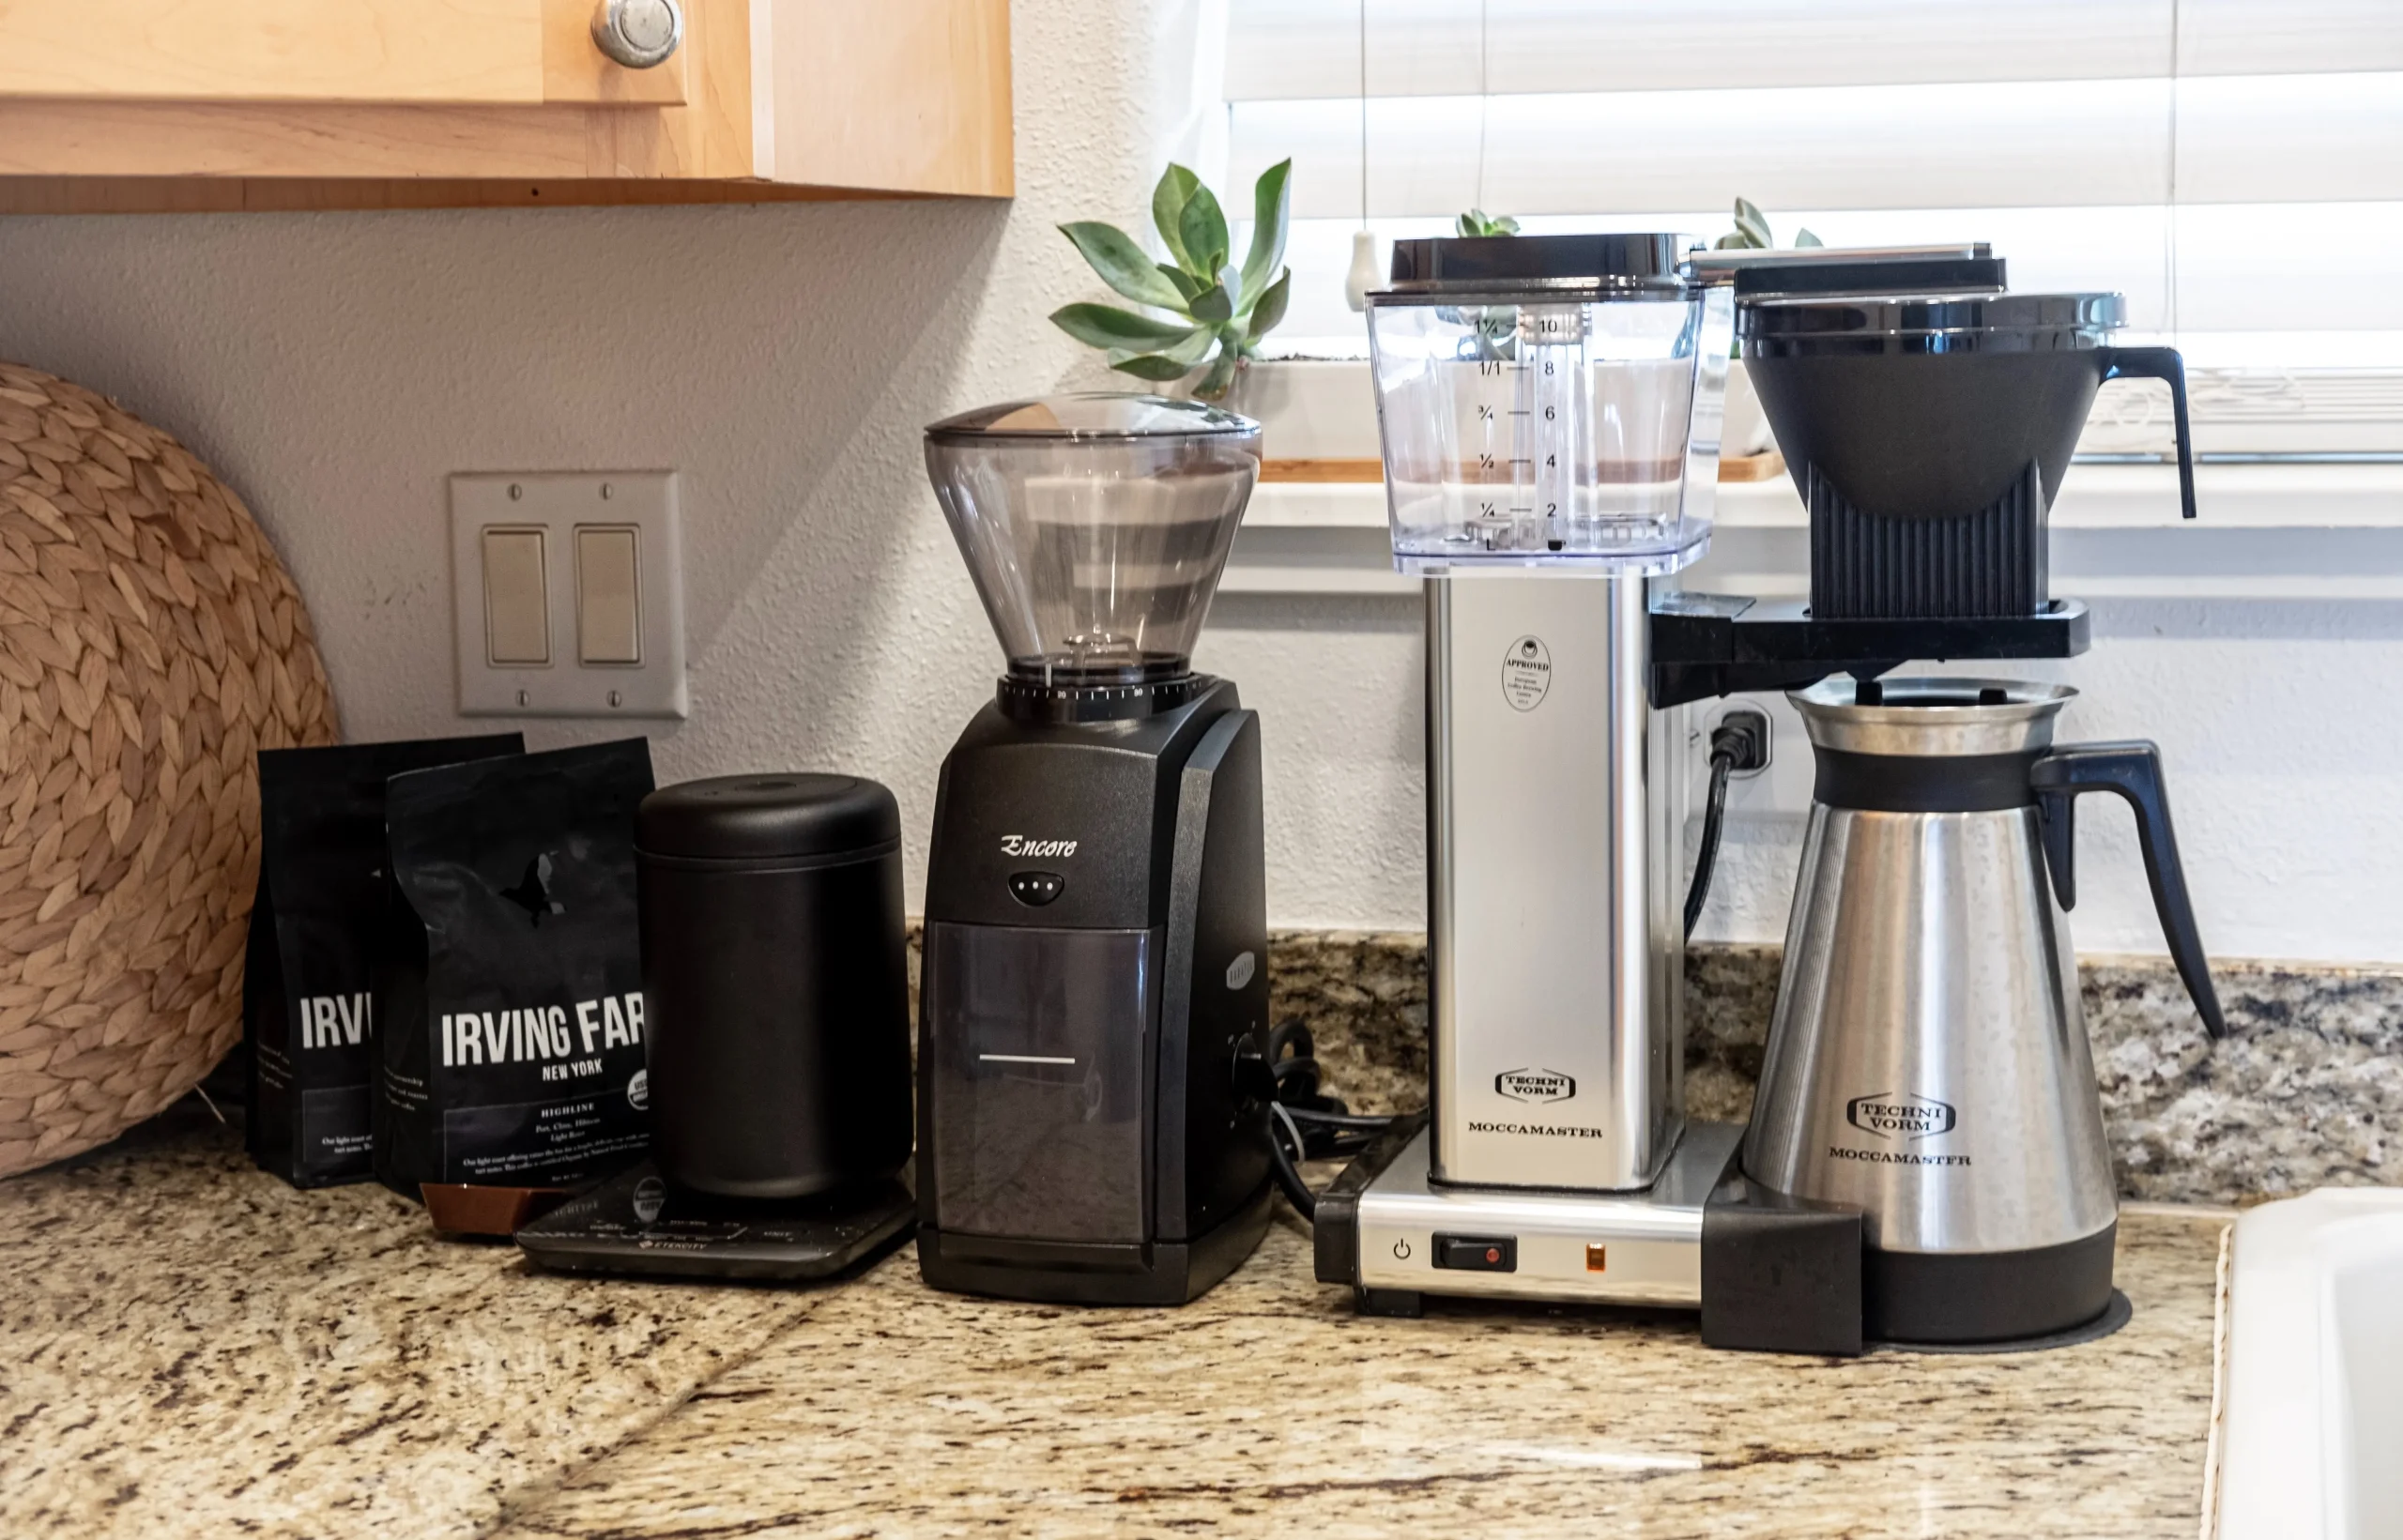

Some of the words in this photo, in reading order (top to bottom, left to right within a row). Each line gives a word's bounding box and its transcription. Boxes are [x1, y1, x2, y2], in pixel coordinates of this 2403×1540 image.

[1538, 319, 1558, 333] 10
[1545, 360, 1554, 375] 8
[1545, 405, 1555, 420] 6
[1546, 454, 1555, 468] 4
[1547, 503, 1556, 517] 2
[1507, 659, 1549, 671] APPROVED
[1001, 834, 1078, 858] Encore
[442, 1005, 571, 1067] IRVING
[542, 1063, 568, 1081] NEW
[571, 1058, 603, 1077] YORK
[1506, 1075, 1566, 1087] TECHNI
[1513, 1085, 1558, 1096] VORM
[542, 1103, 595, 1119] HIGHLINE
[1861, 1103, 1941, 1118] TECHNI
[1468, 1121, 1603, 1139] MOCCAMASTER
[1870, 1117, 1931, 1131] VORM
[1829, 1146, 1971, 1166] MOCCAMASTER
